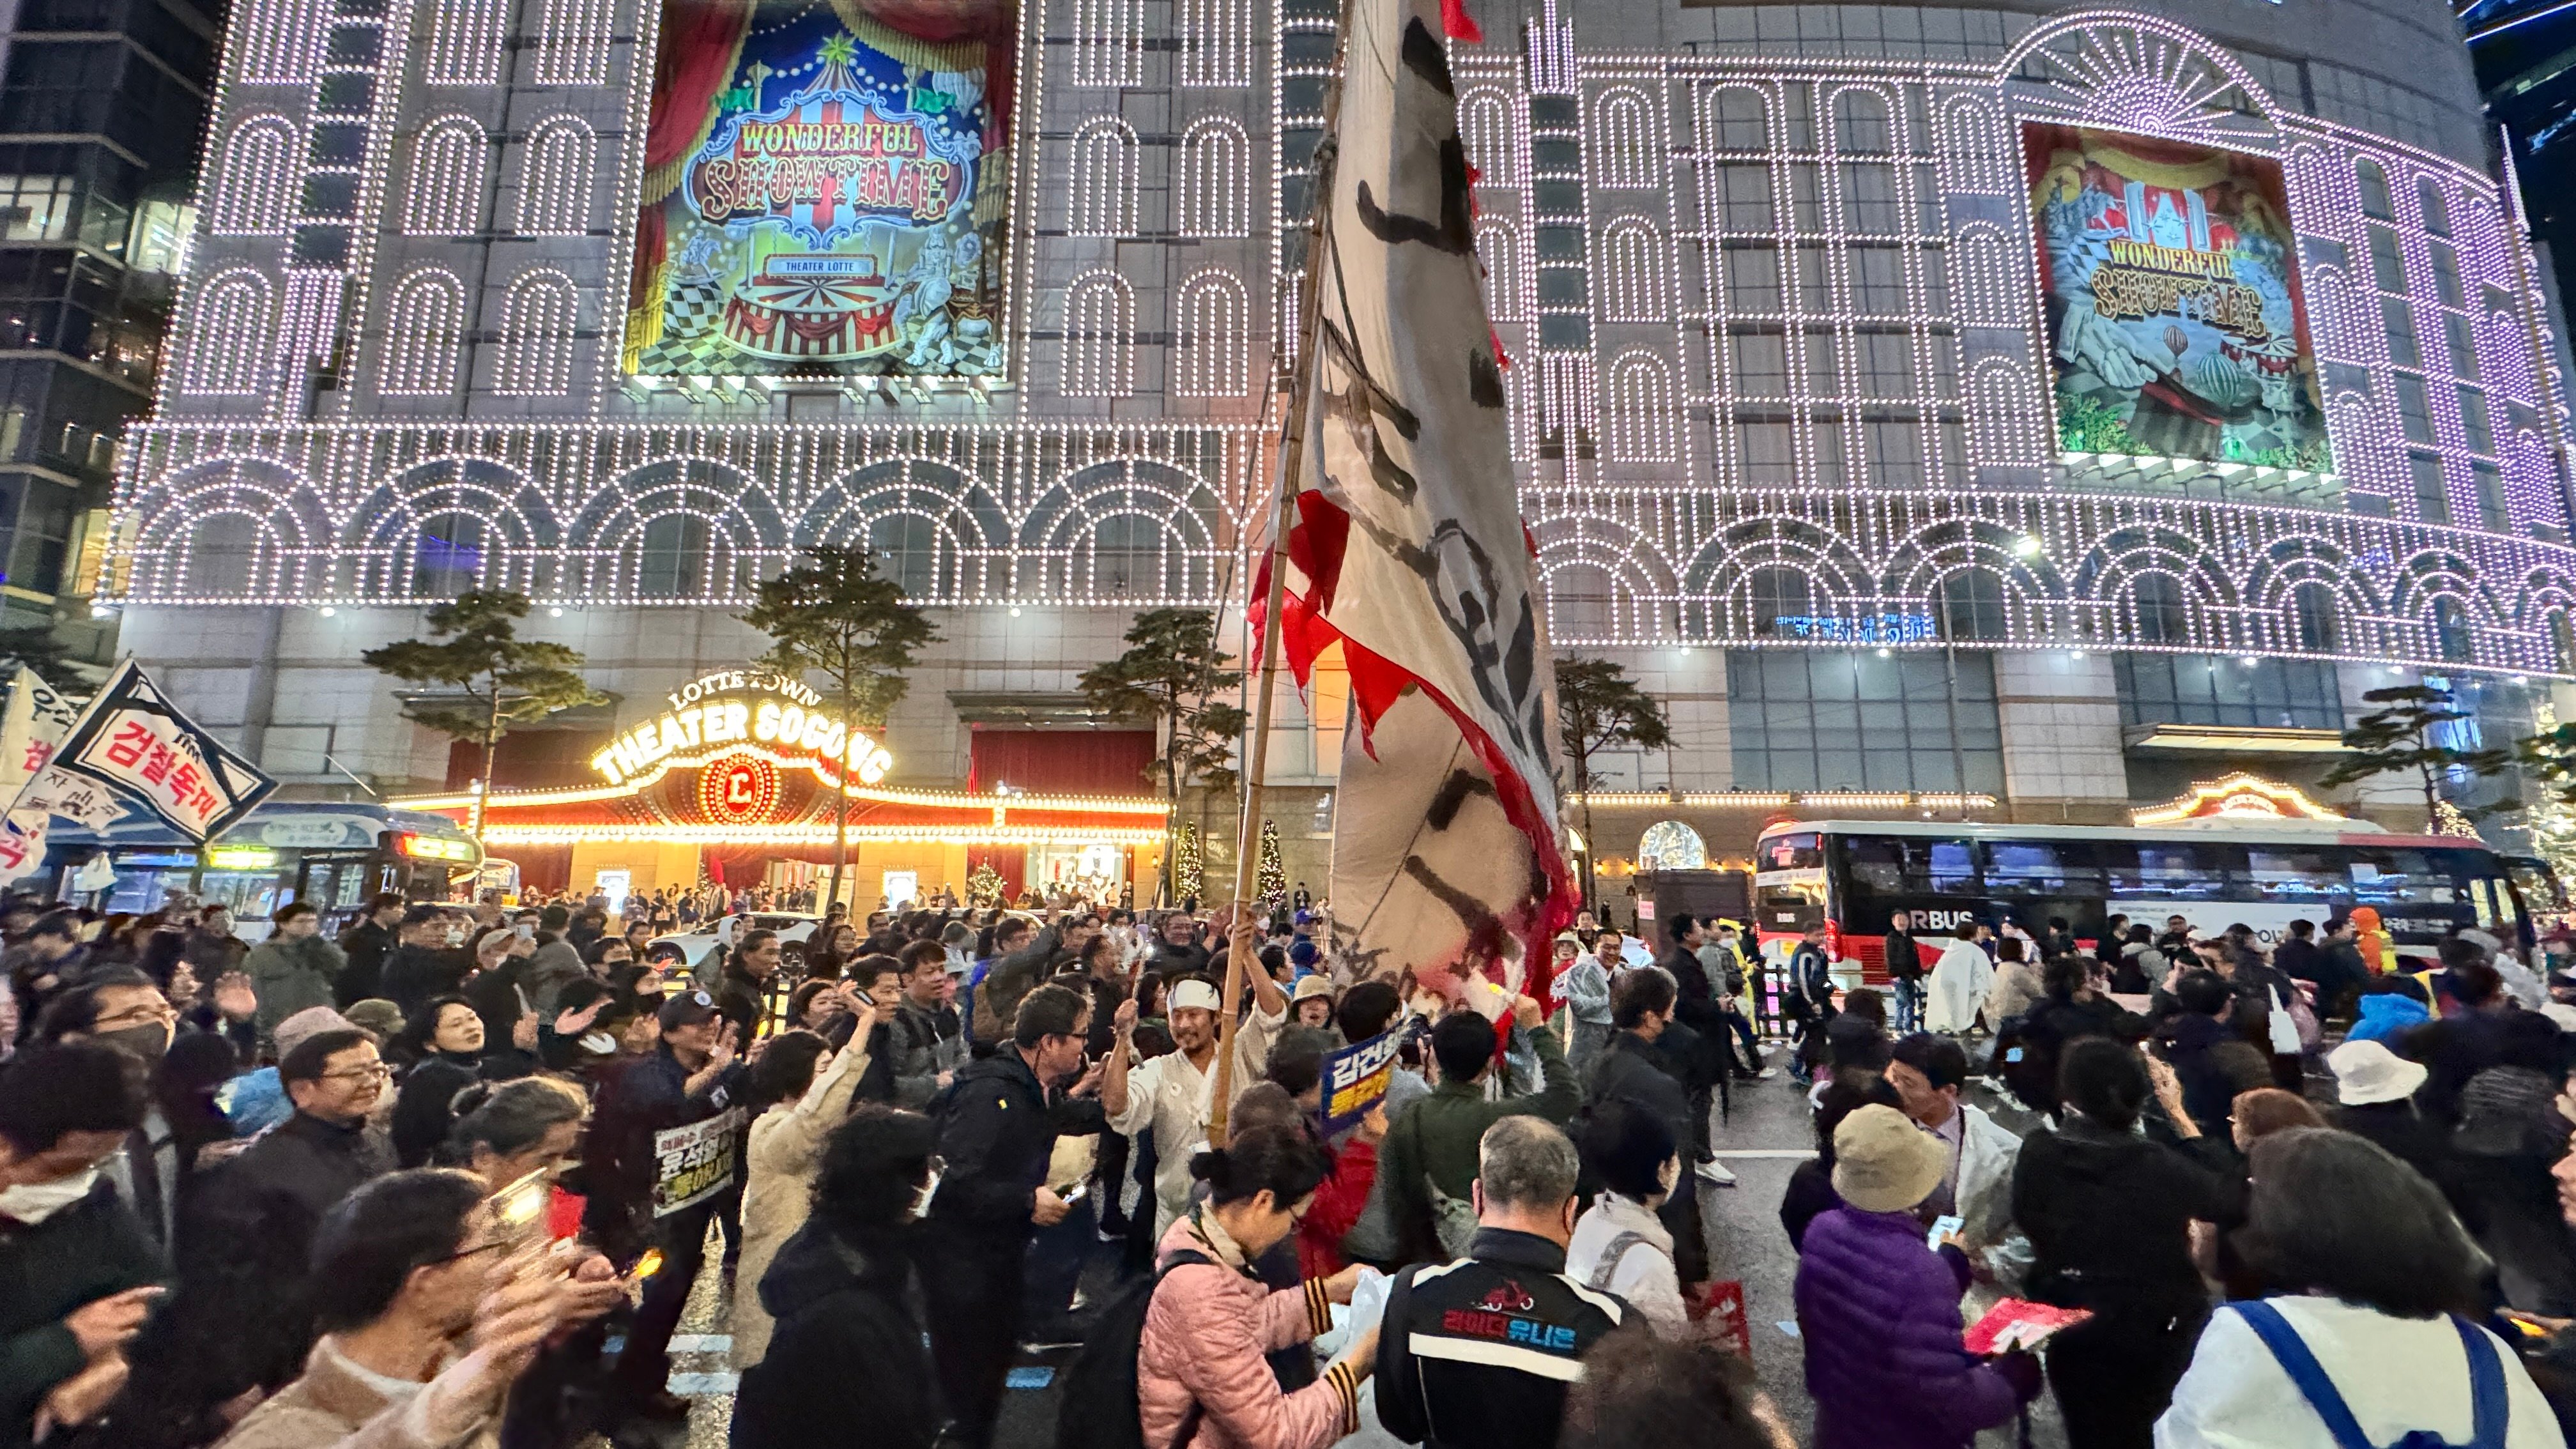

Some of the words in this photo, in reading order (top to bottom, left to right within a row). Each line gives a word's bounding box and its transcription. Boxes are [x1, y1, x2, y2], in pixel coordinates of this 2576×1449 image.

[741, 123, 919, 155] WONDERFUL
[701, 156, 950, 221] SHOWTIME
[786, 261, 825, 272] THEATER
[827, 261, 854, 272] LOTTE
[2109, 240, 2235, 279] WONDERFUL
[2091, 266, 2267, 339] SHOWTIME
[668, 670, 745, 712] LOTTE
[749, 670, 823, 707] TOWN
[592, 701, 749, 785] THEATER
[754, 700, 893, 785] SOGONG
[106, 721, 217, 821] 검찰독재
